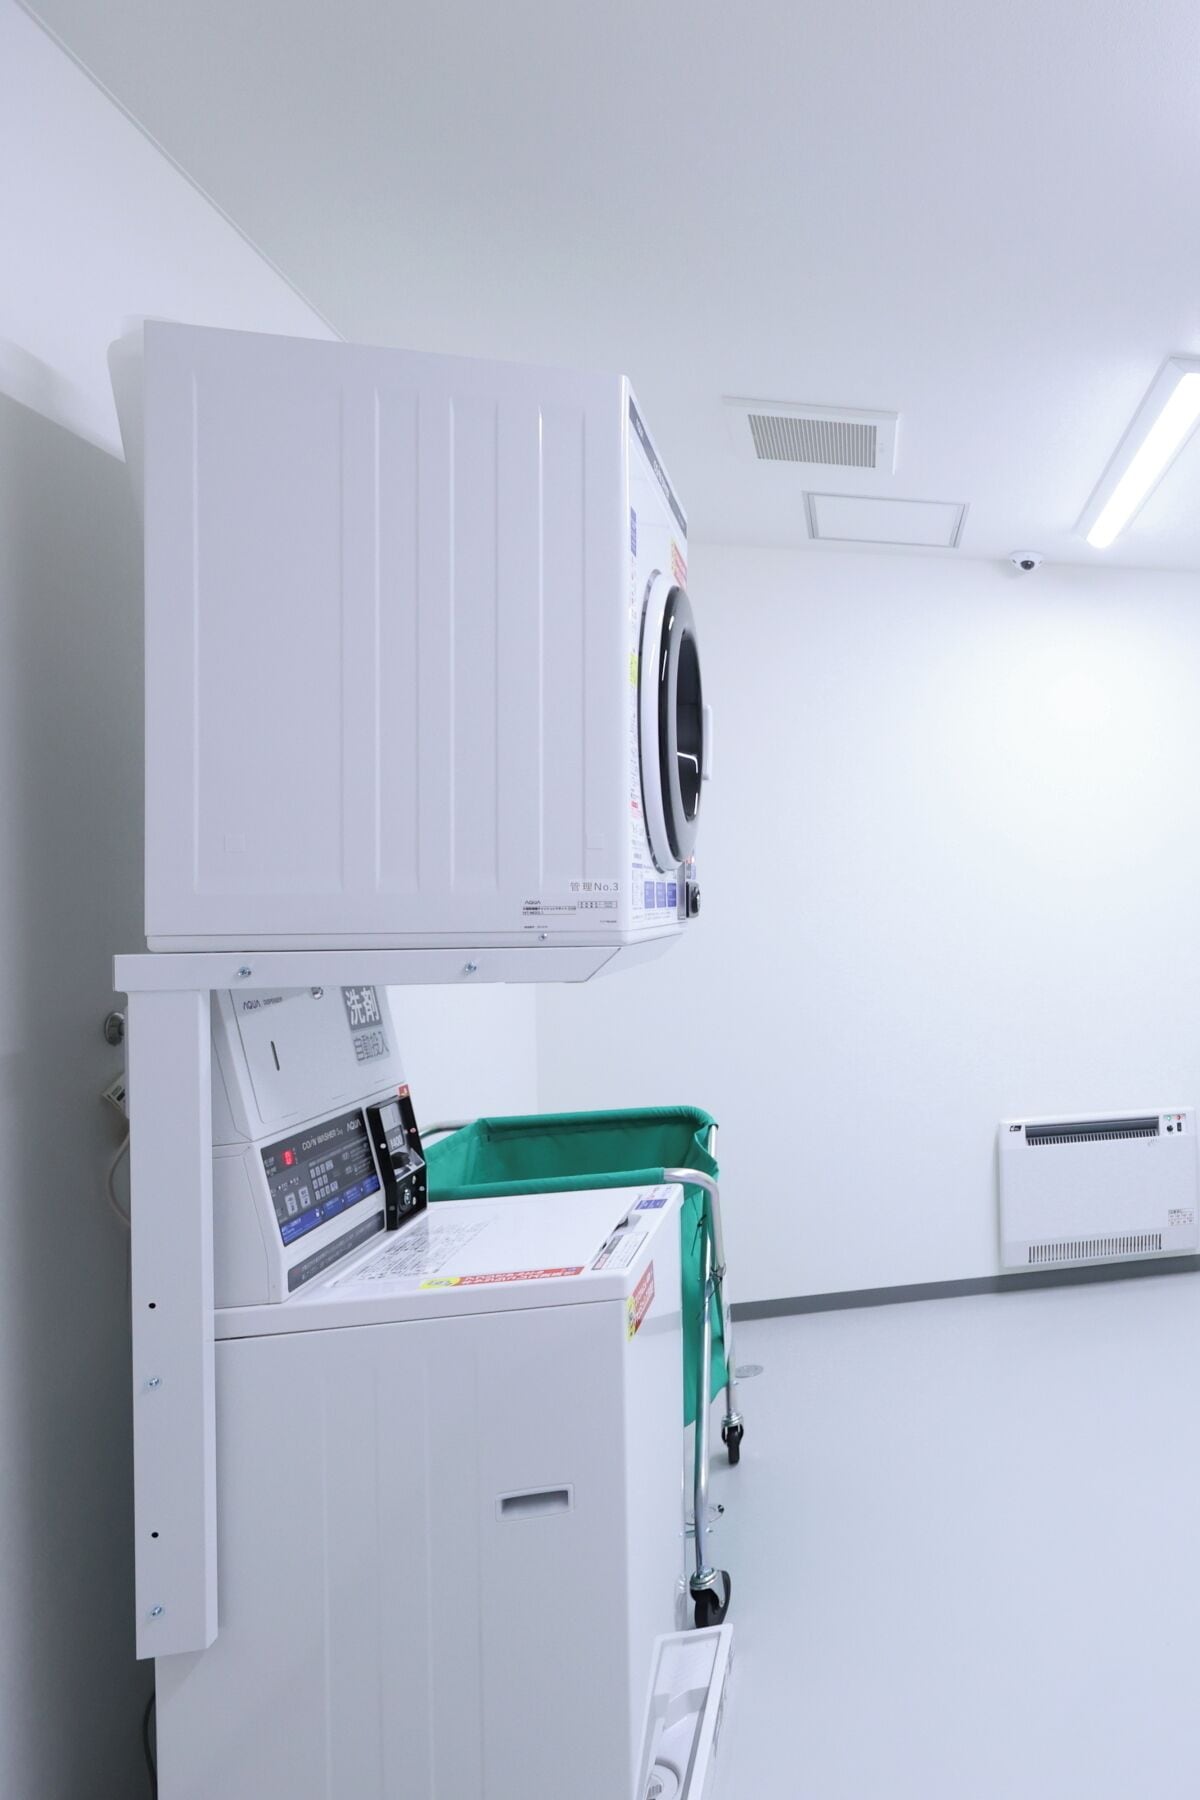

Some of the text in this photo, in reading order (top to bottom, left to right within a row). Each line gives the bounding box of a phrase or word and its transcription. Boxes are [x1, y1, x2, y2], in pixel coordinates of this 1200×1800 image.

[570, 881, 619, 892] 管理No.3
[243, 999, 262, 1011] AQUA
[345, 987, 380, 1026] 洗剤
[353, 1031, 390, 1062] 自動投入
